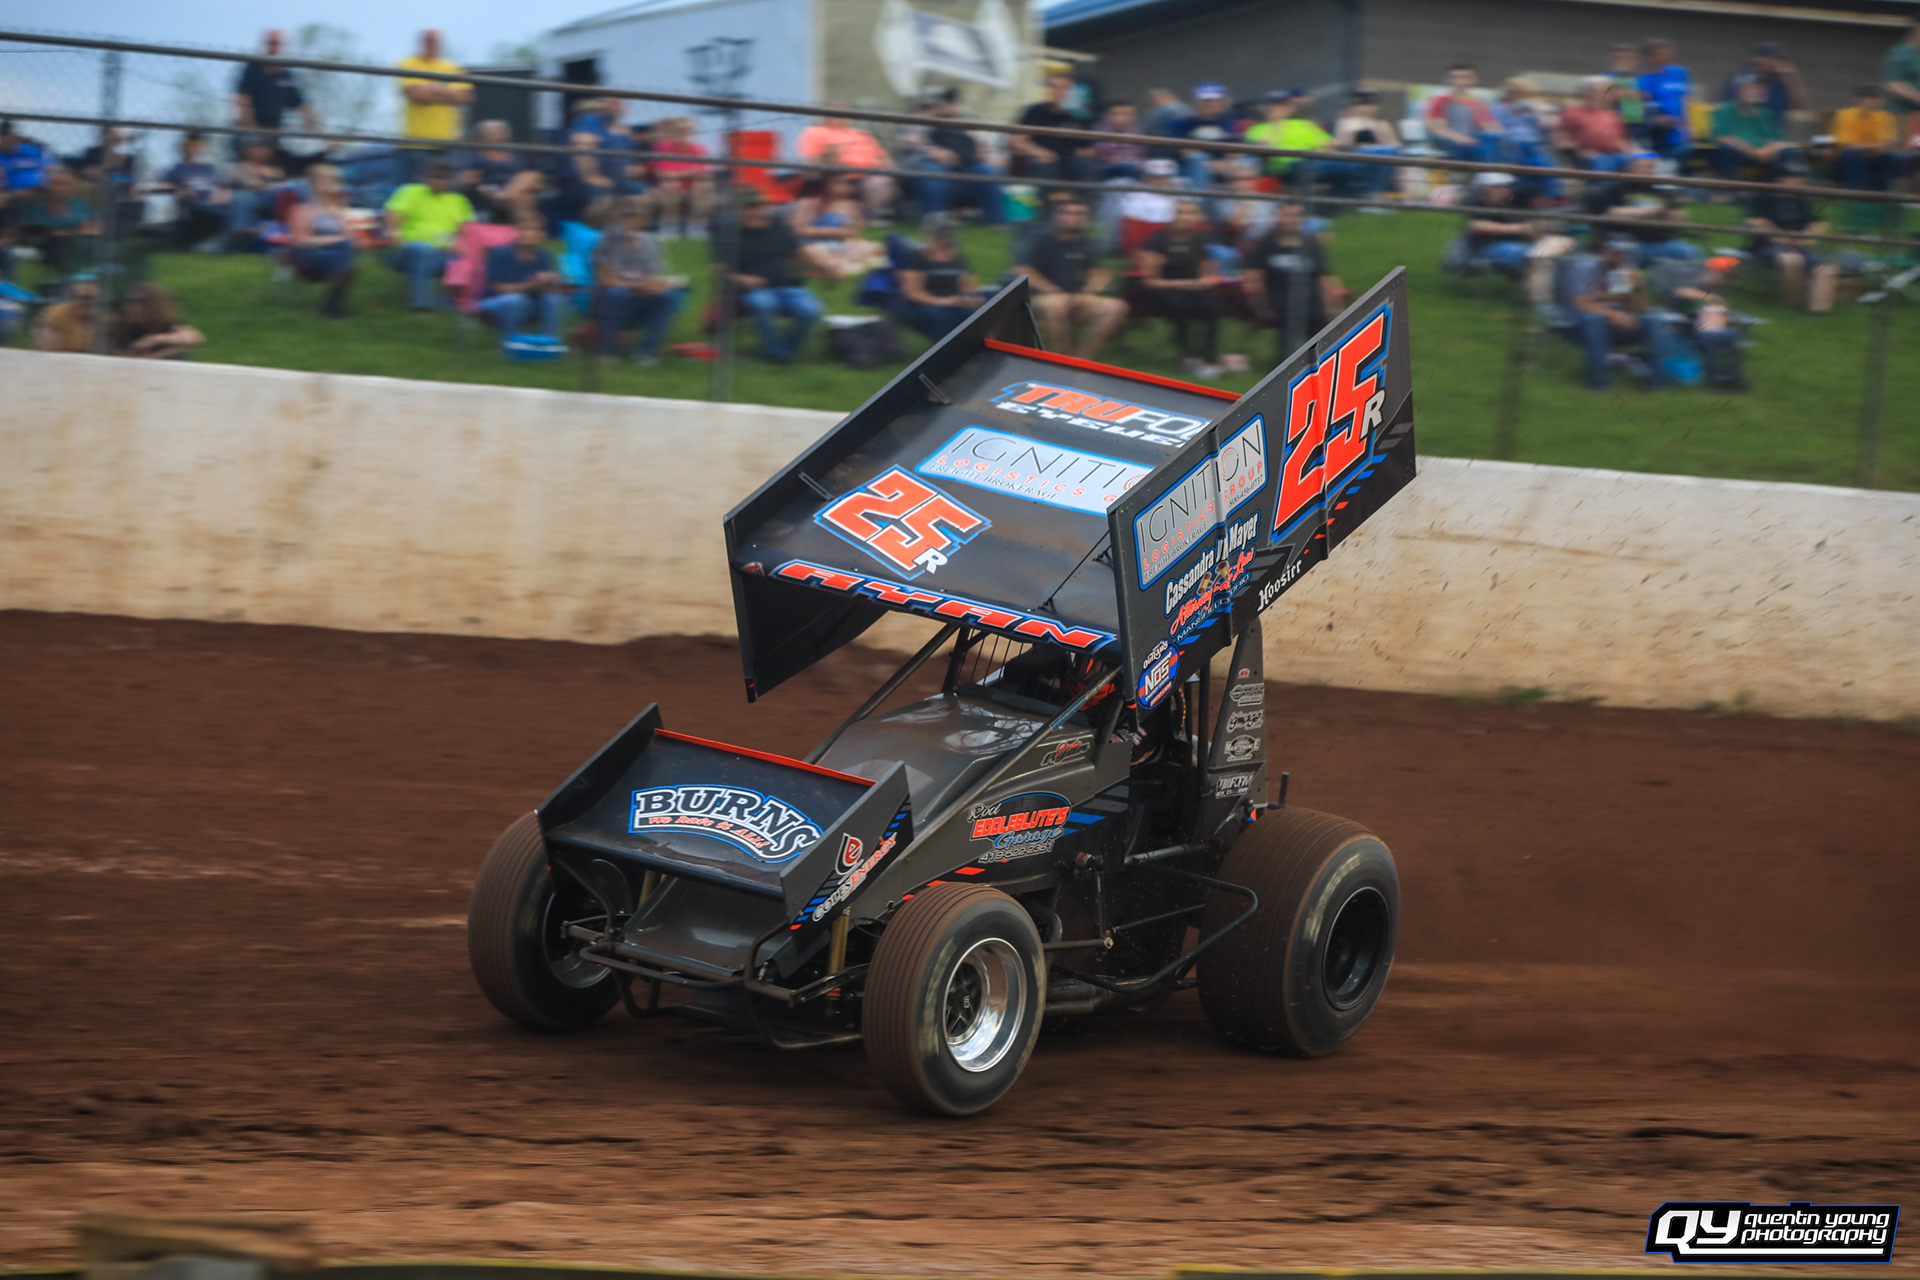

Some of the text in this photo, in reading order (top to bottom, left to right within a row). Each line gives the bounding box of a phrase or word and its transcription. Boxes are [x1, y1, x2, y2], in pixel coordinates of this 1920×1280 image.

[1014, 383, 1211, 441] TRUFO
[936, 455, 1086, 497] LOGISTICS
[1140, 423, 1261, 553] IGNITION
[1143, 501, 1214, 569] LOGISTICS
[1165, 549, 1215, 615] Cassandra
[1228, 512, 1259, 553] Mayer
[1257, 559, 1303, 612] Hoosier
[1144, 649, 1173, 698] NOS
[635, 786, 822, 859] BURNS
[648, 816, 673, 825] We
[967, 802, 1002, 821] Rod
[994, 827, 1063, 850] Garage
